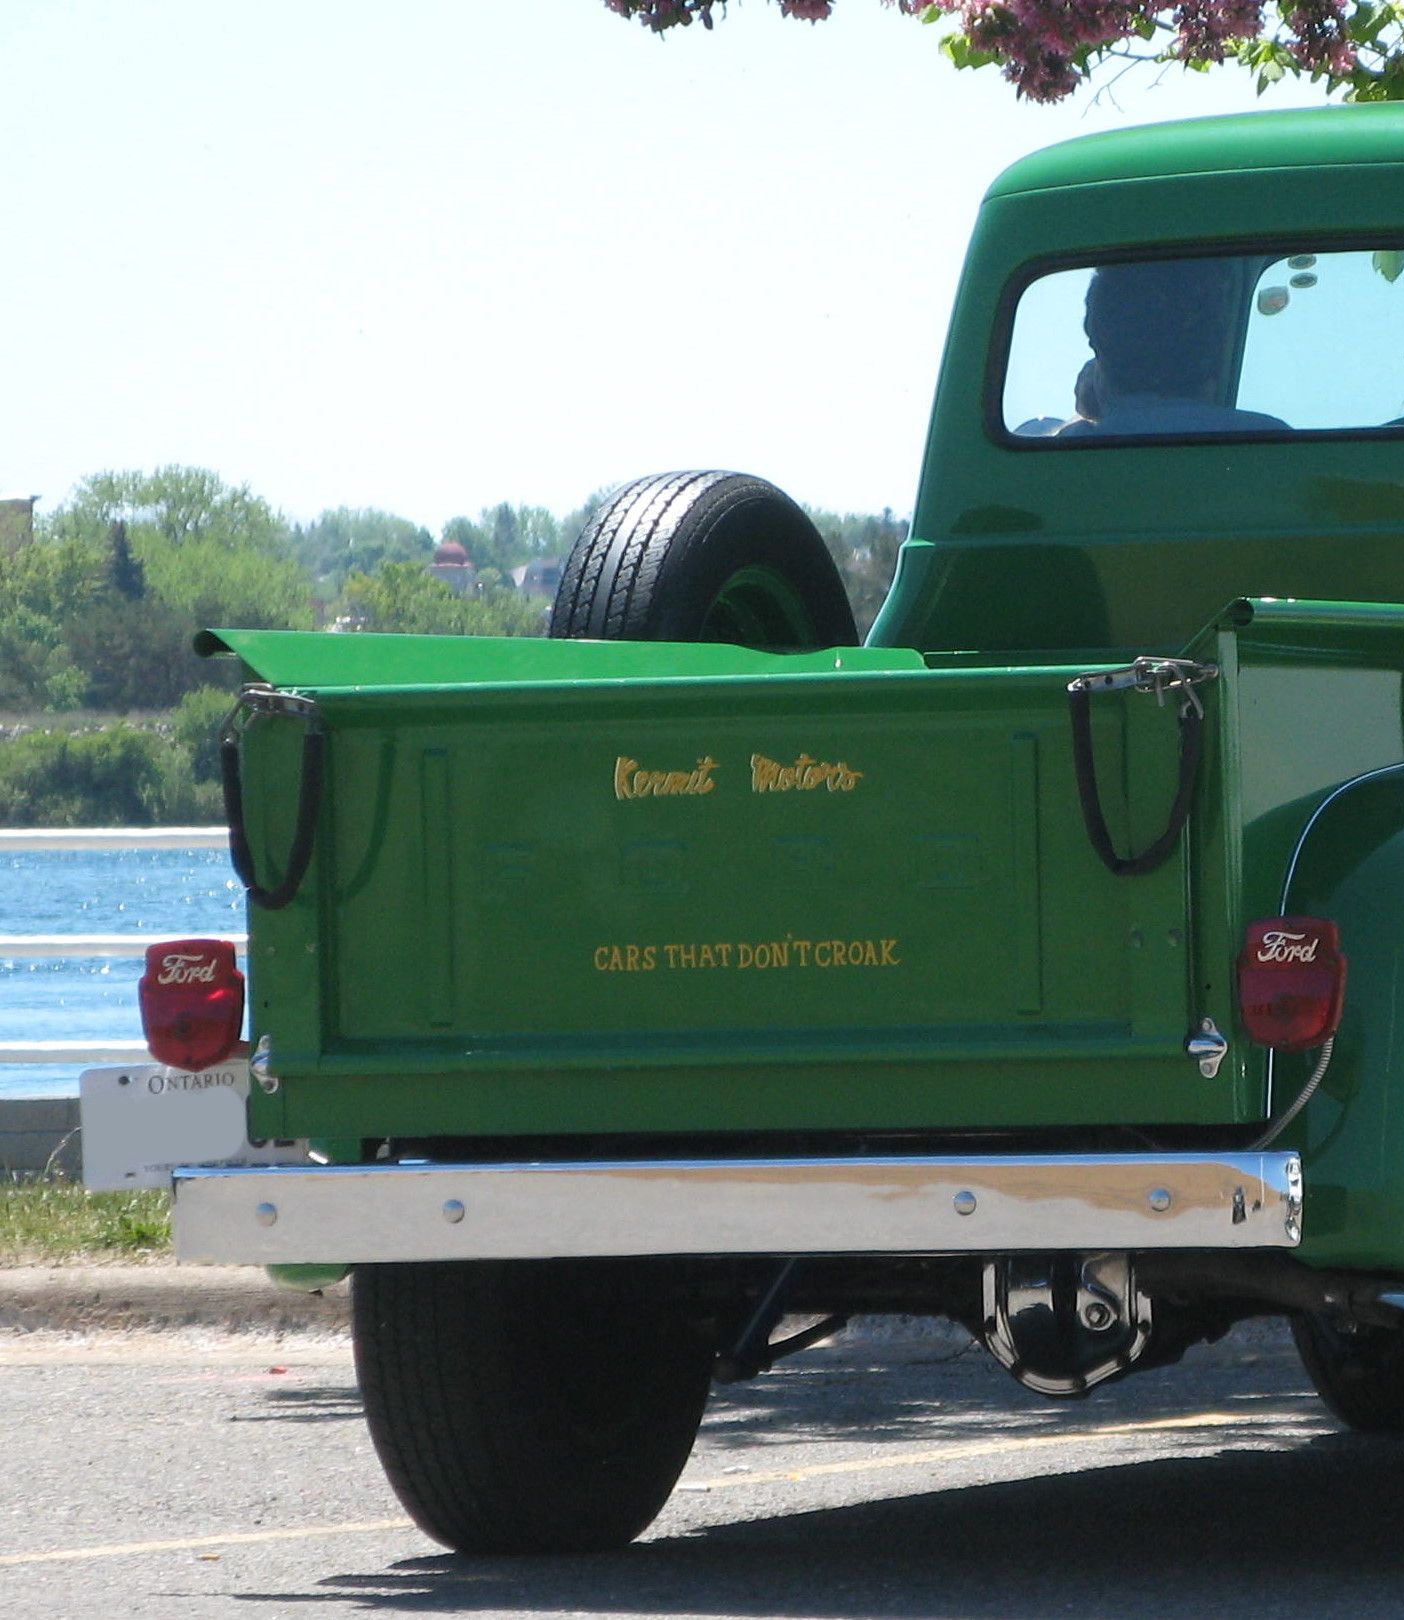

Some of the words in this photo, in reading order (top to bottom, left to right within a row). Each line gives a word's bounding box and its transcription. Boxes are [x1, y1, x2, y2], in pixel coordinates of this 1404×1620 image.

[751, 753, 864, 793] Motors
[593, 945, 657, 971] CARS
[664, 943, 732, 969] THAT
[737, 932, 812, 969] DON'T
[814, 939, 902, 967] CROAK
[1257, 931, 1319, 963] Ford
[157, 954, 217, 985] Ford
[147, 1071, 235, 1095] ONTARIO
